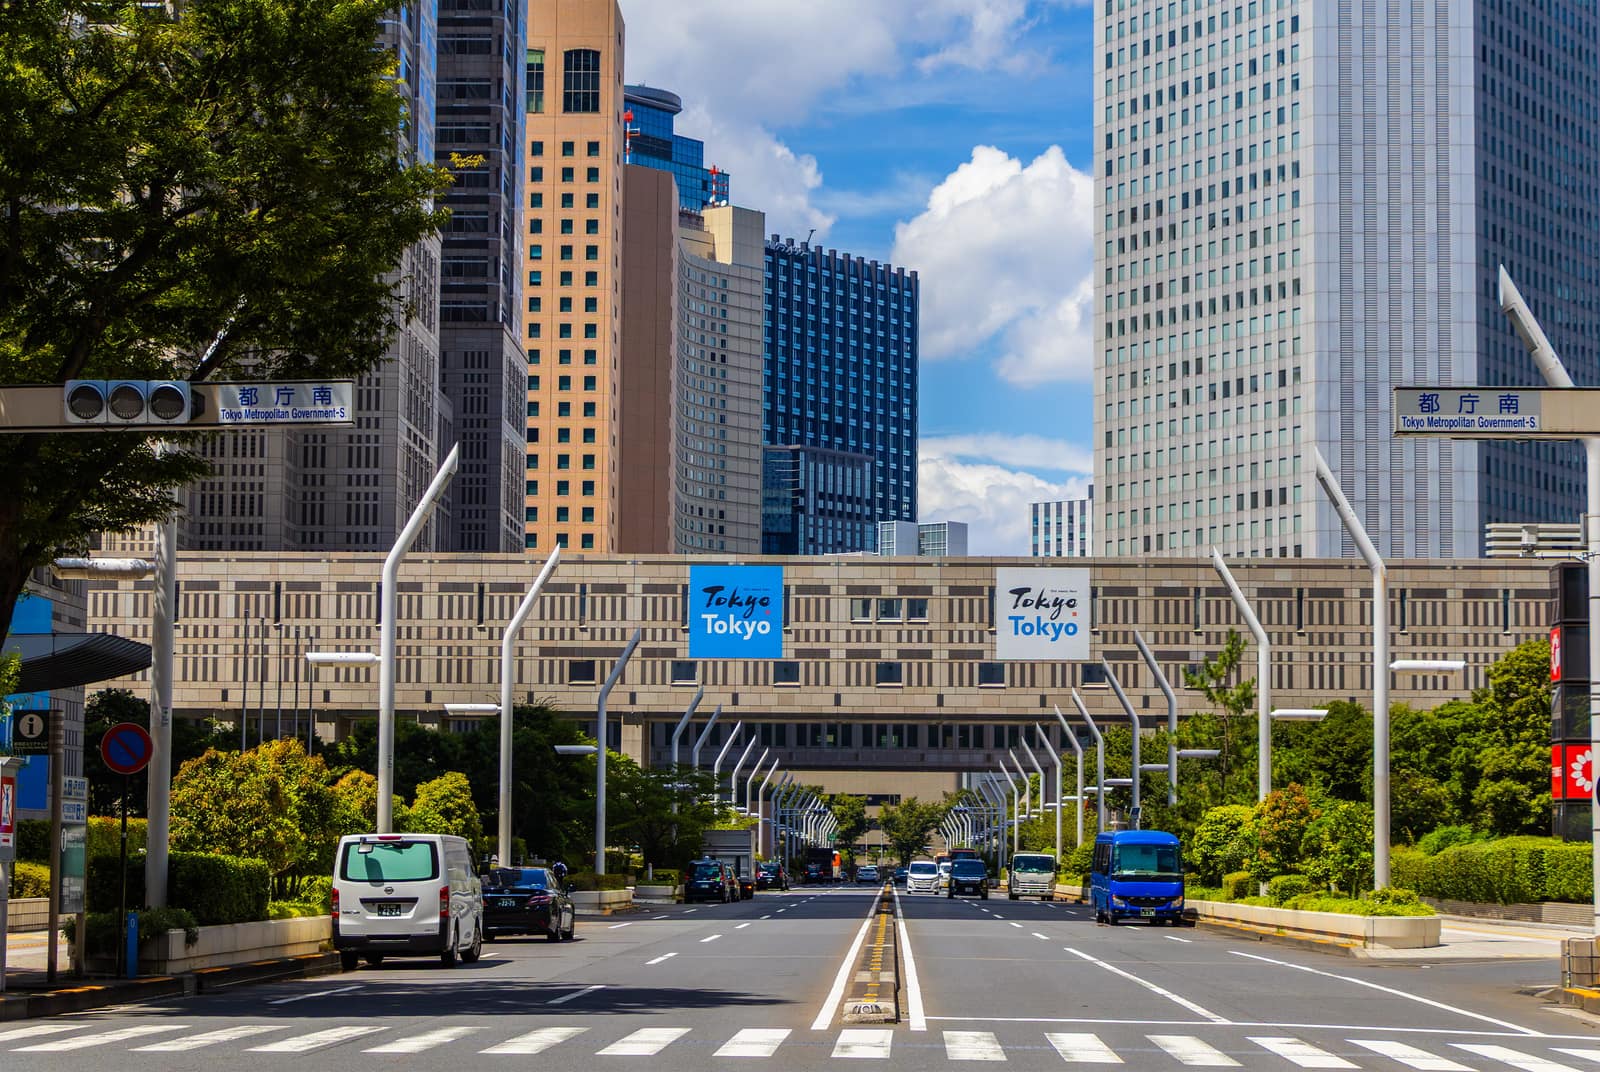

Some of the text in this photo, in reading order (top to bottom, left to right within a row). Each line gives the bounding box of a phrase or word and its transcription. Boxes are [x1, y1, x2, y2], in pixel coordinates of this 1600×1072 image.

[239, 386, 332, 406] 都庁南
[1418, 392, 1519, 414] 都庁南
[221, 408, 242, 421] Tokyo
[245, 408, 289, 421] Metropolitan
[1402, 416, 1424, 429] Tokyo
[1427, 416, 1475, 429] Metropolitan
[702, 585, 770, 618] Tokyo
[1009, 587, 1077, 620] Tokyo
[701, 614, 770, 640] Tokyo
[1008, 615, 1078, 641] Tokyo
